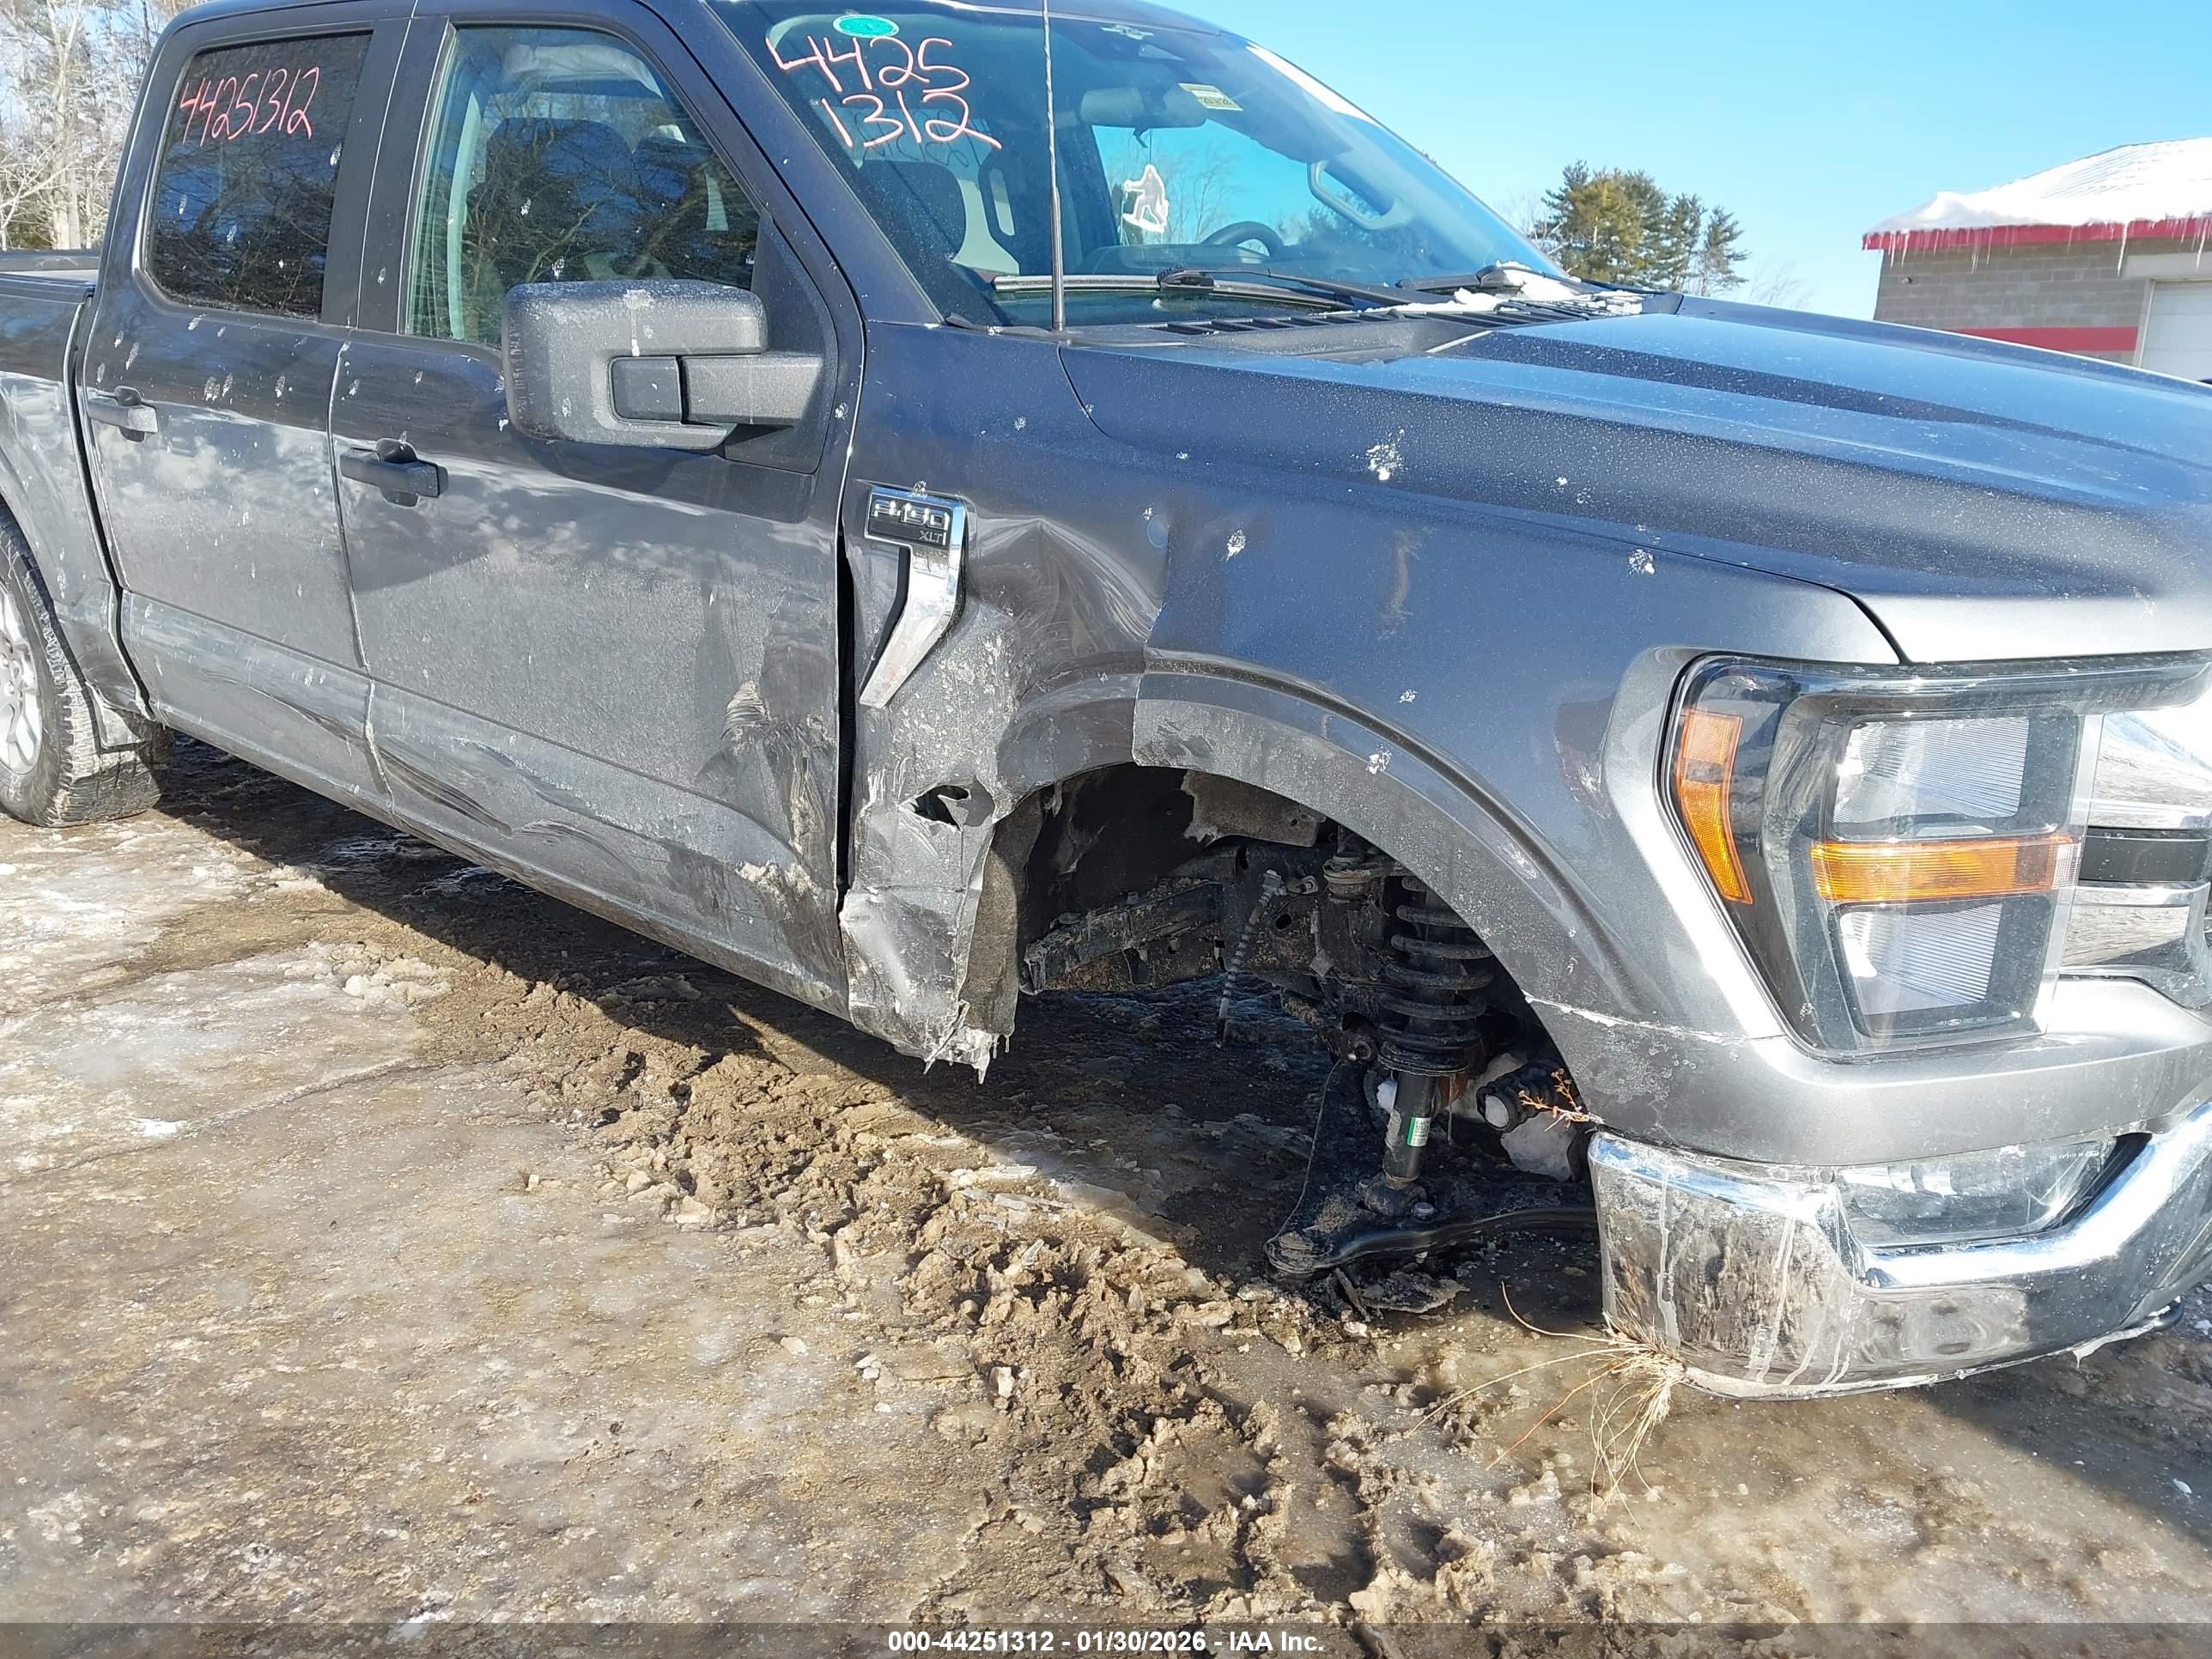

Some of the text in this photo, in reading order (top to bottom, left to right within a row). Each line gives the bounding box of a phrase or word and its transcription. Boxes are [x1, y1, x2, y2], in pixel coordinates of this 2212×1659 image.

[765, 36, 970, 93] 4425
[179, 66, 319, 147] 44251312
[821, 90, 1003, 149] 1312
[919, 529, 944, 544] XLT
